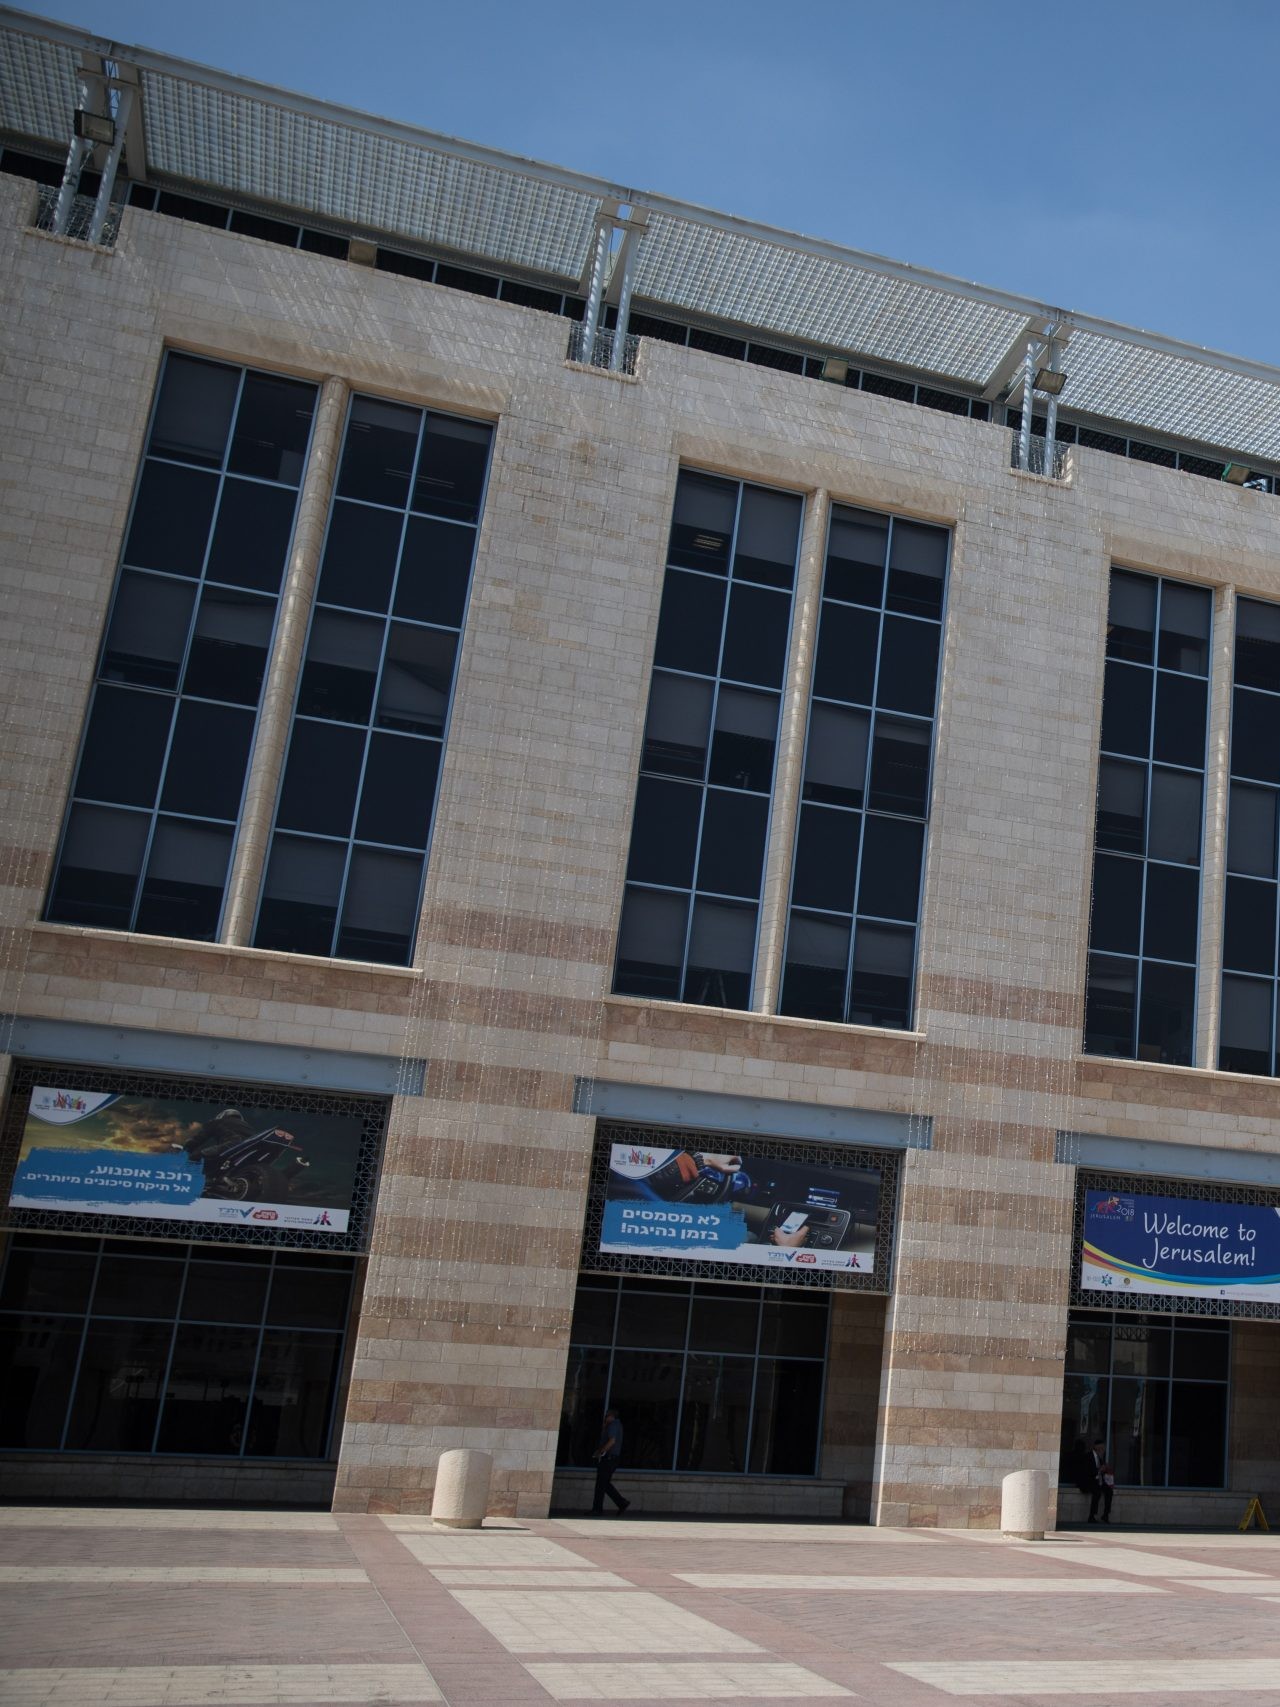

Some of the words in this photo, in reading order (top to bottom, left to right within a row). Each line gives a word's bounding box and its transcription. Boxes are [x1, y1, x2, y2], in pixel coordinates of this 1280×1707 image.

[90, 1165, 151, 1178] אופנוע,
[155, 1169, 193, 1182] רוכב
[22, 1172, 81, 1184] מיותרים.
[84, 1177, 132, 1188] סיכונים
[135, 1181, 170, 1192] תיקח
[173, 1182, 191, 1193] אל
[622, 1209, 693, 1224] מסמסים
[1116, 1204, 1135, 1217] 2018
[697, 1214, 721, 1226] לא
[1090, 1213, 1121, 1221] JERUSALEM
[621, 1223, 677, 1238] נהיגה!
[1143, 1212, 1229, 1239] Welcome
[1238, 1223, 1257, 1242] to
[680, 1229, 719, 1241] בזמן
[1142, 1237, 1256, 1269] Jerusalem!
